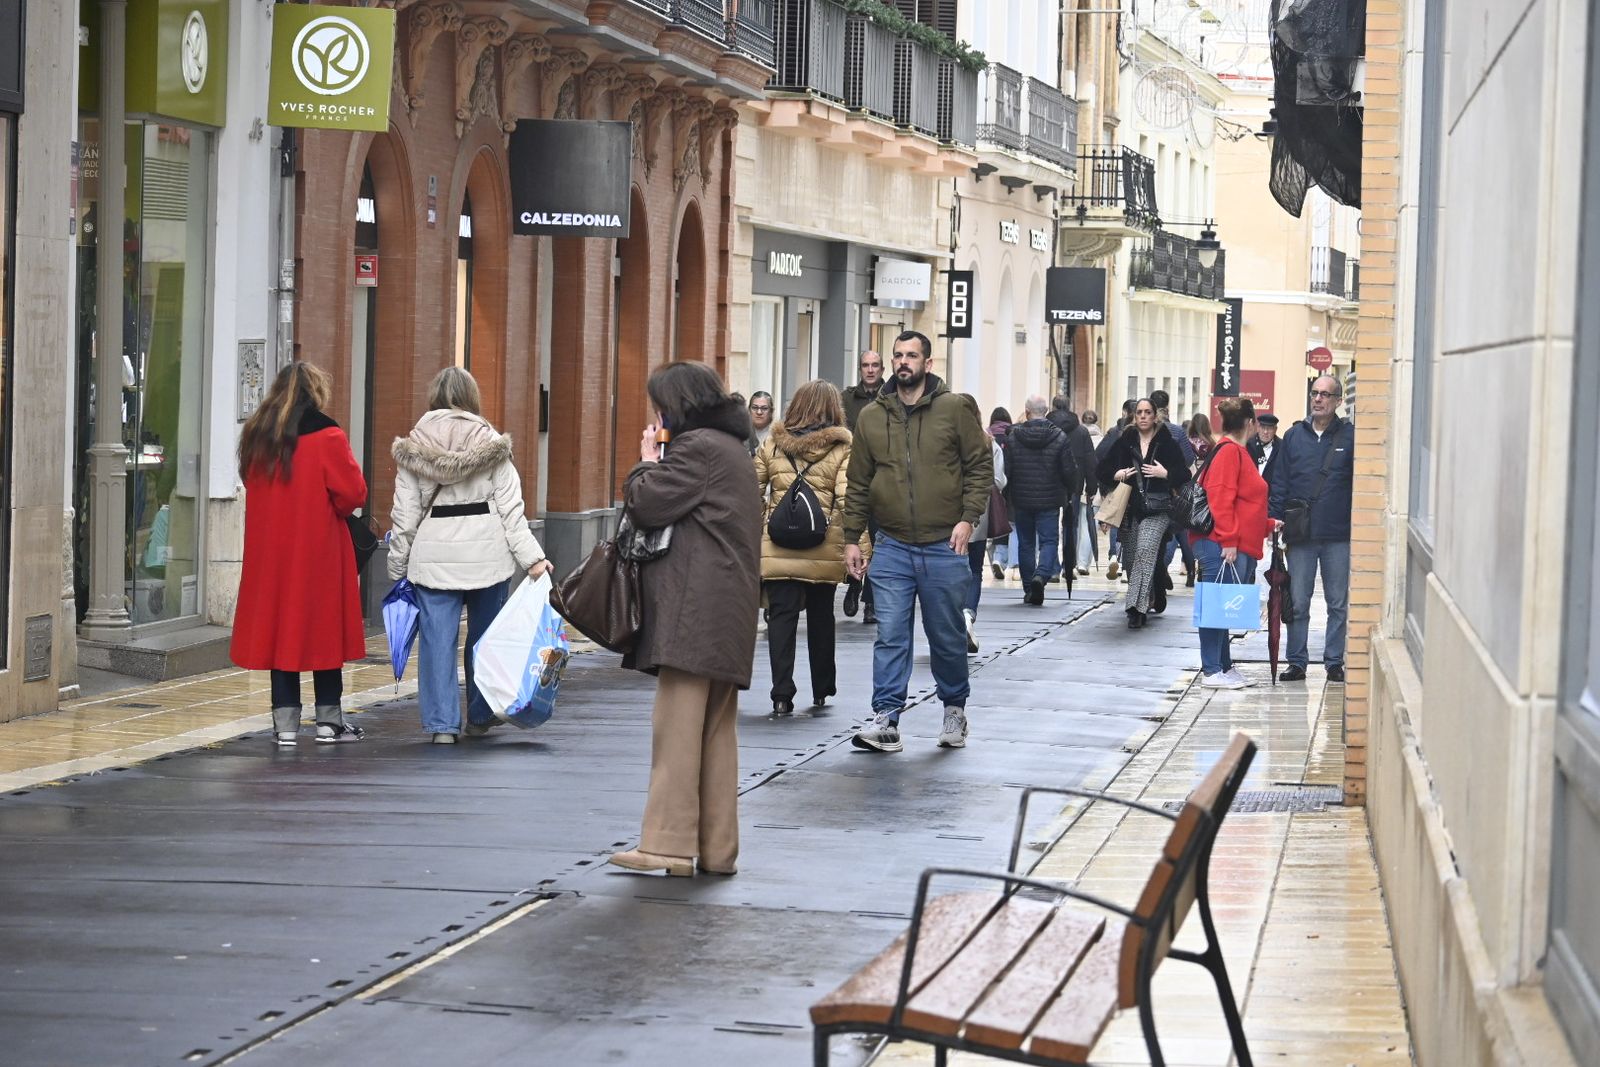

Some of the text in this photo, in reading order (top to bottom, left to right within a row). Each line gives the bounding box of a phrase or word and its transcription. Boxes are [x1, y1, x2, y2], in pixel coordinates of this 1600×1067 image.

[280, 102, 375, 116] YVES ROCHER
[305, 114, 348, 122] FRANCE
[520, 211, 622, 227] CALZEDONIA
[1224, 304, 1233, 335] VIAJES
